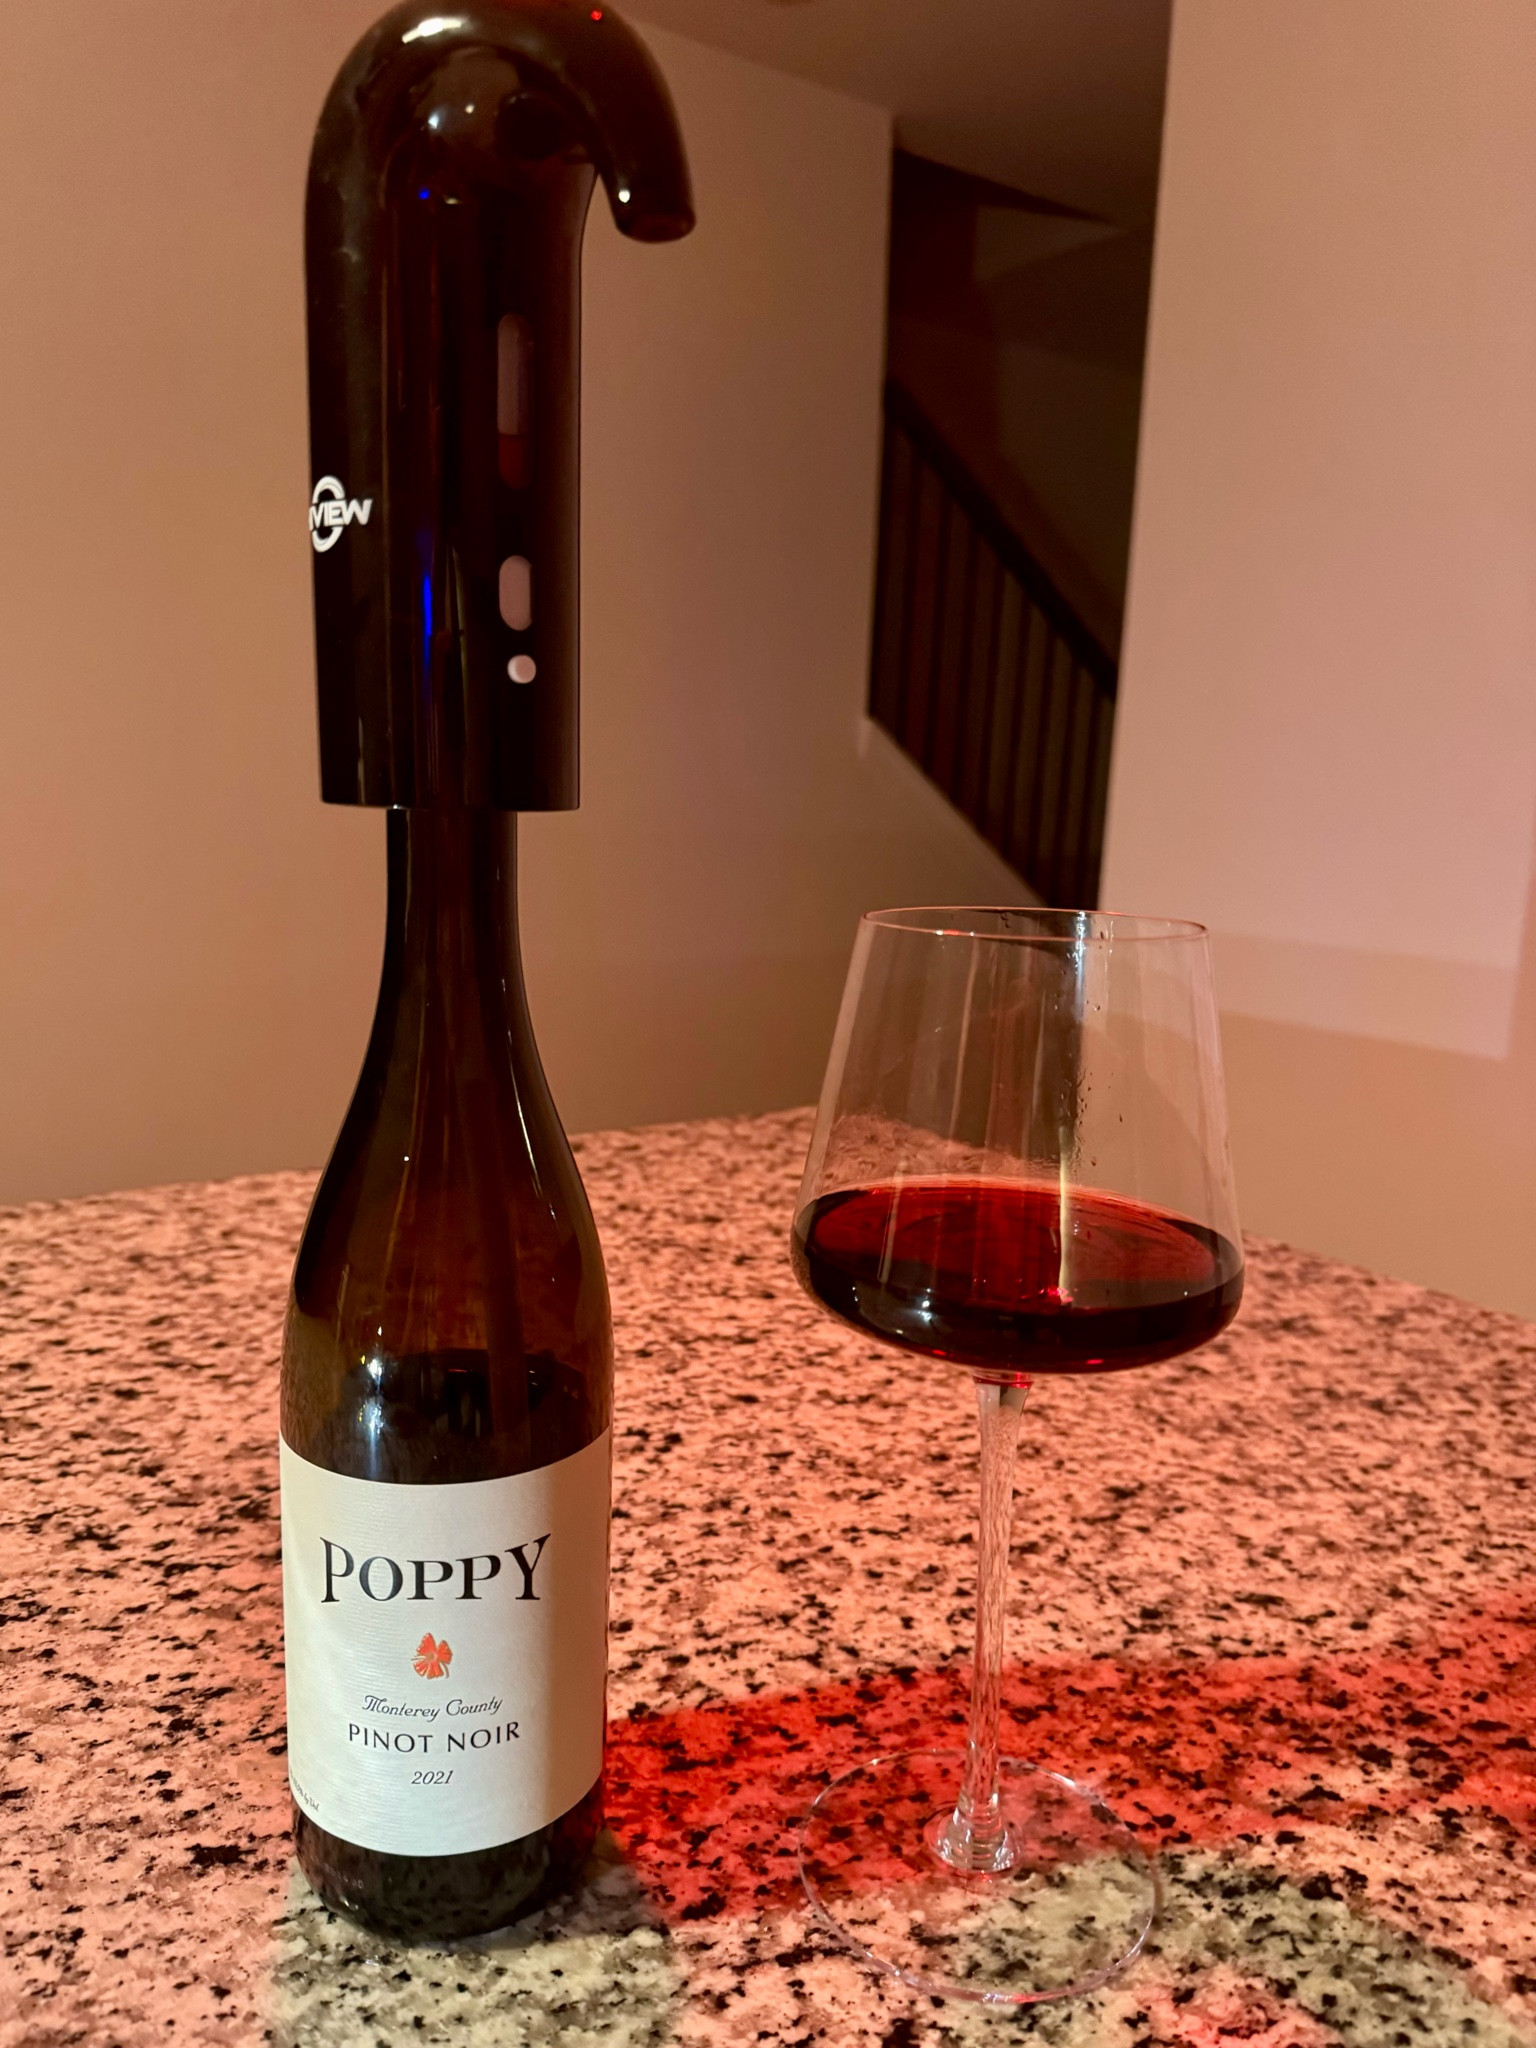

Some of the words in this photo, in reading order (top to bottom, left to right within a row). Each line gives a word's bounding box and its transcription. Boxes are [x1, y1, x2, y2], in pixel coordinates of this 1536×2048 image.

[319, 1533, 551, 1604] POPPY
[361, 1694, 440, 1722] Monterey
[445, 1696, 503, 1716] County
[348, 1723, 433, 1753] PINOT
[447, 1721, 520, 1753] NOIR
[411, 1769, 454, 1785] 2021
